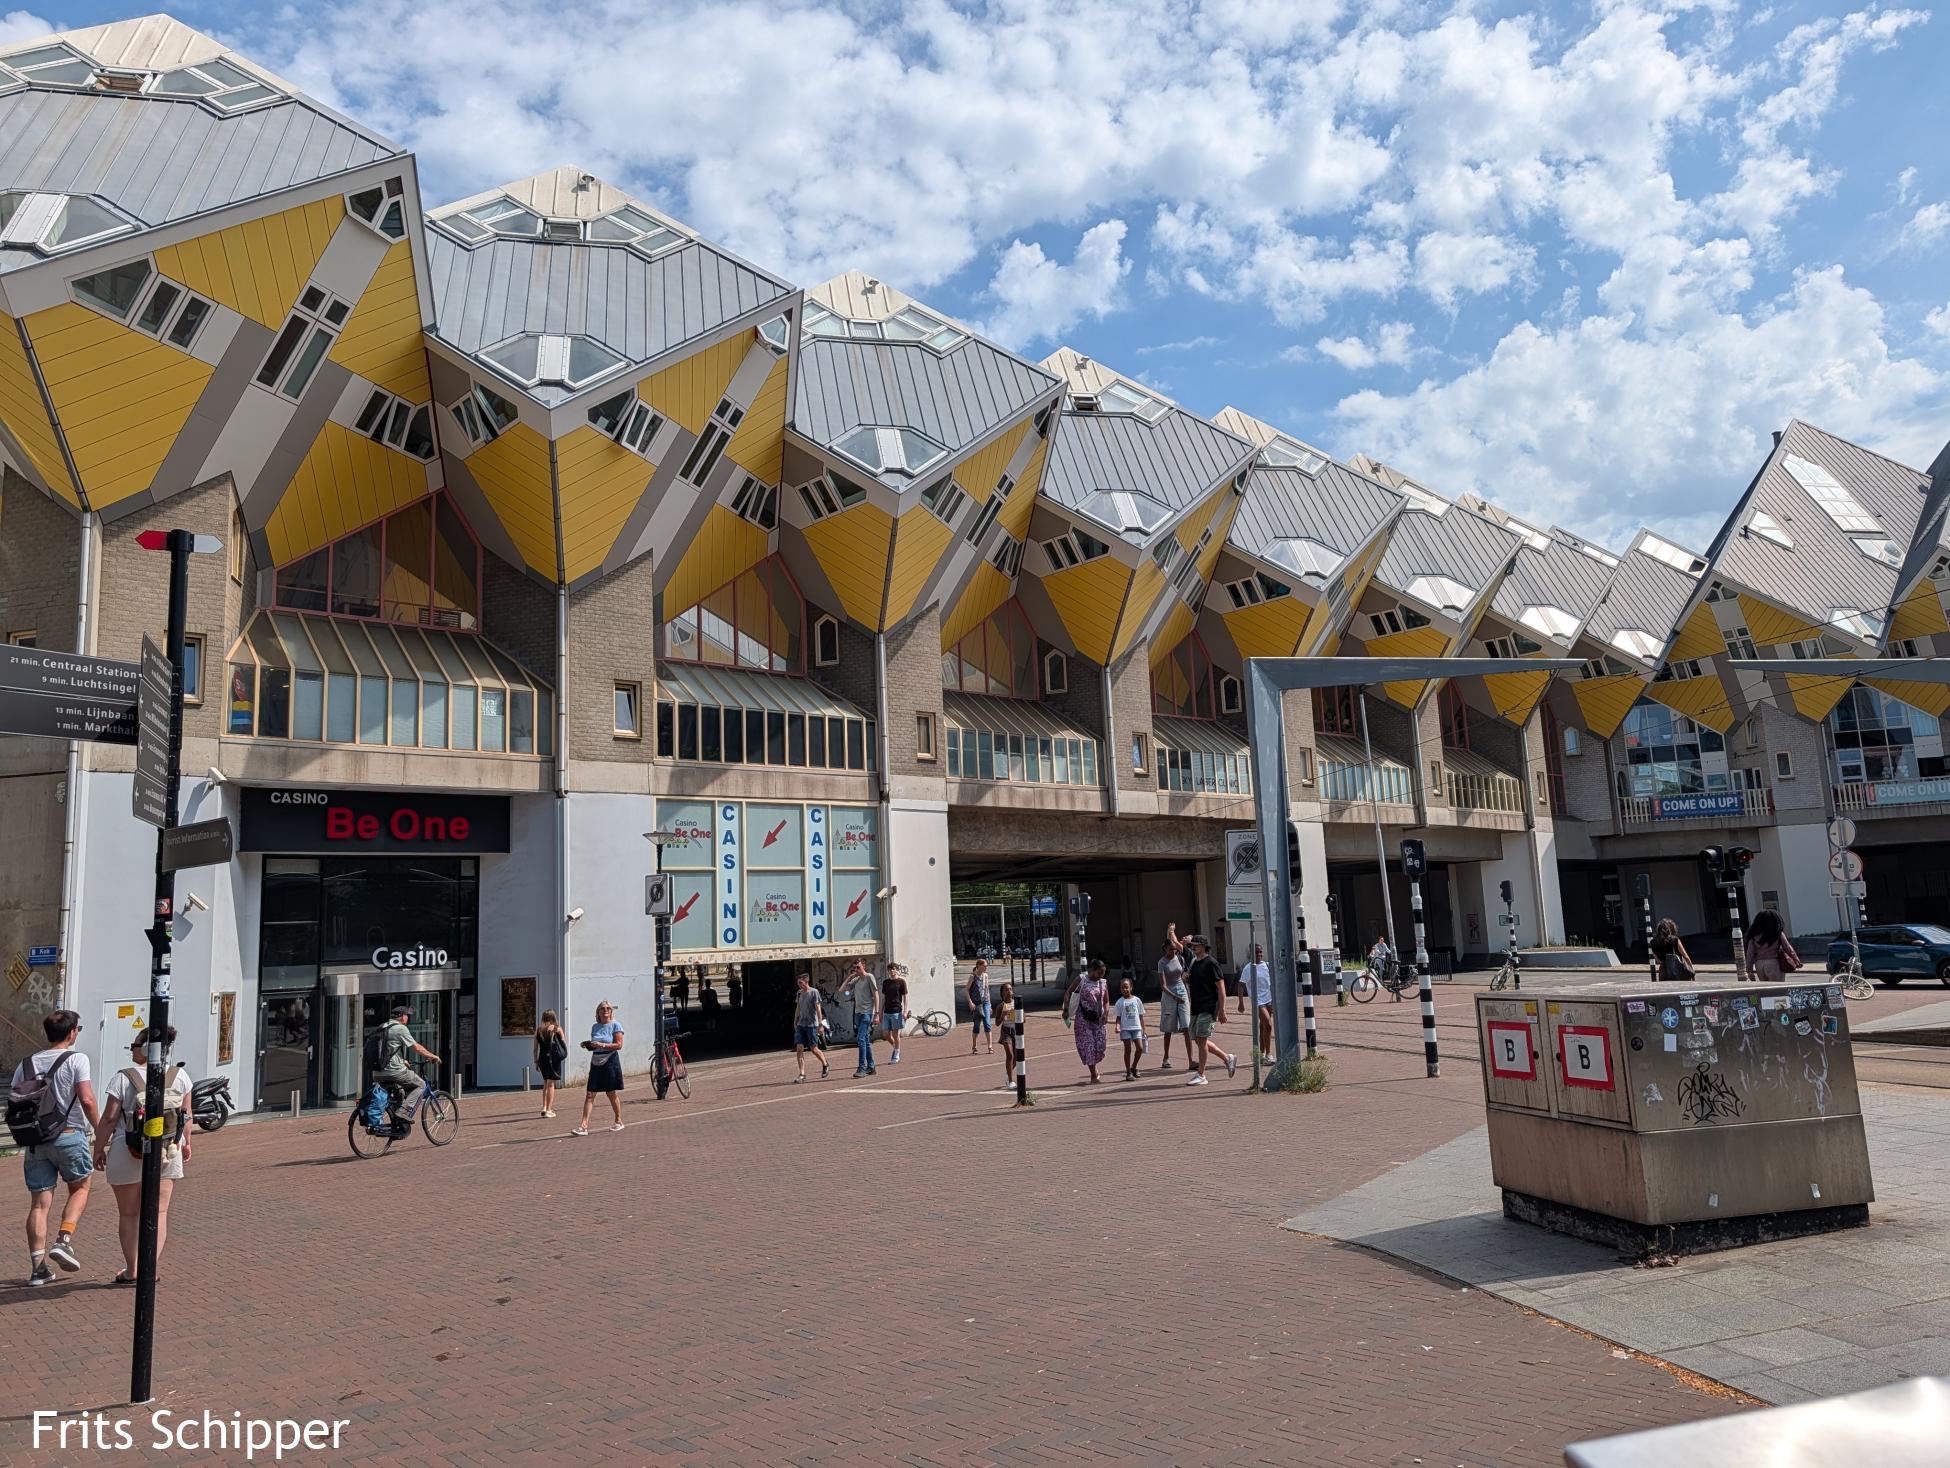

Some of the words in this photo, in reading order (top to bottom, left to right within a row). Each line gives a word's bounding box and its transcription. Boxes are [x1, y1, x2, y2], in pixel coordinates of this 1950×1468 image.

[10, 656, 19, 664] 21
[21, 658, 41, 667] min.
[42, 658, 93, 673] Centraal
[96, 665, 137, 679] Station
[49, 677, 69, 686] min.
[70, 677, 137, 694] Luchtsingel
[66, 708, 85, 716] min.
[87, 707, 135, 720] Lijnbaan
[62, 721, 82, 731] min.
[84, 722, 134, 736] Markthal
[270, 792, 328, 805] CASINO
[1879, 786, 1916, 798] COME
[1917, 784, 1936, 796] ON
[1662, 800, 1697, 811] COME
[1698, 798, 1716, 809] ON
[1717, 796, 1739, 808] UP!
[326, 807, 380, 839] Be
[390, 809, 470, 841] One
[675, 819, 697, 827] Casino
[674, 828, 688, 839] Be
[690, 828, 712, 839] One
[845, 832, 857, 842] Be
[858, 832, 876, 842] One
[722, 805, 737, 944] CASINO
[810, 808, 825, 940] CASINO
[765, 902, 778, 912] Be
[780, 902, 800, 912] One
[372, 944, 448, 968] Casino
[1504, 1039, 1516, 1062] B
[1577, 1045, 1591, 1069] B
